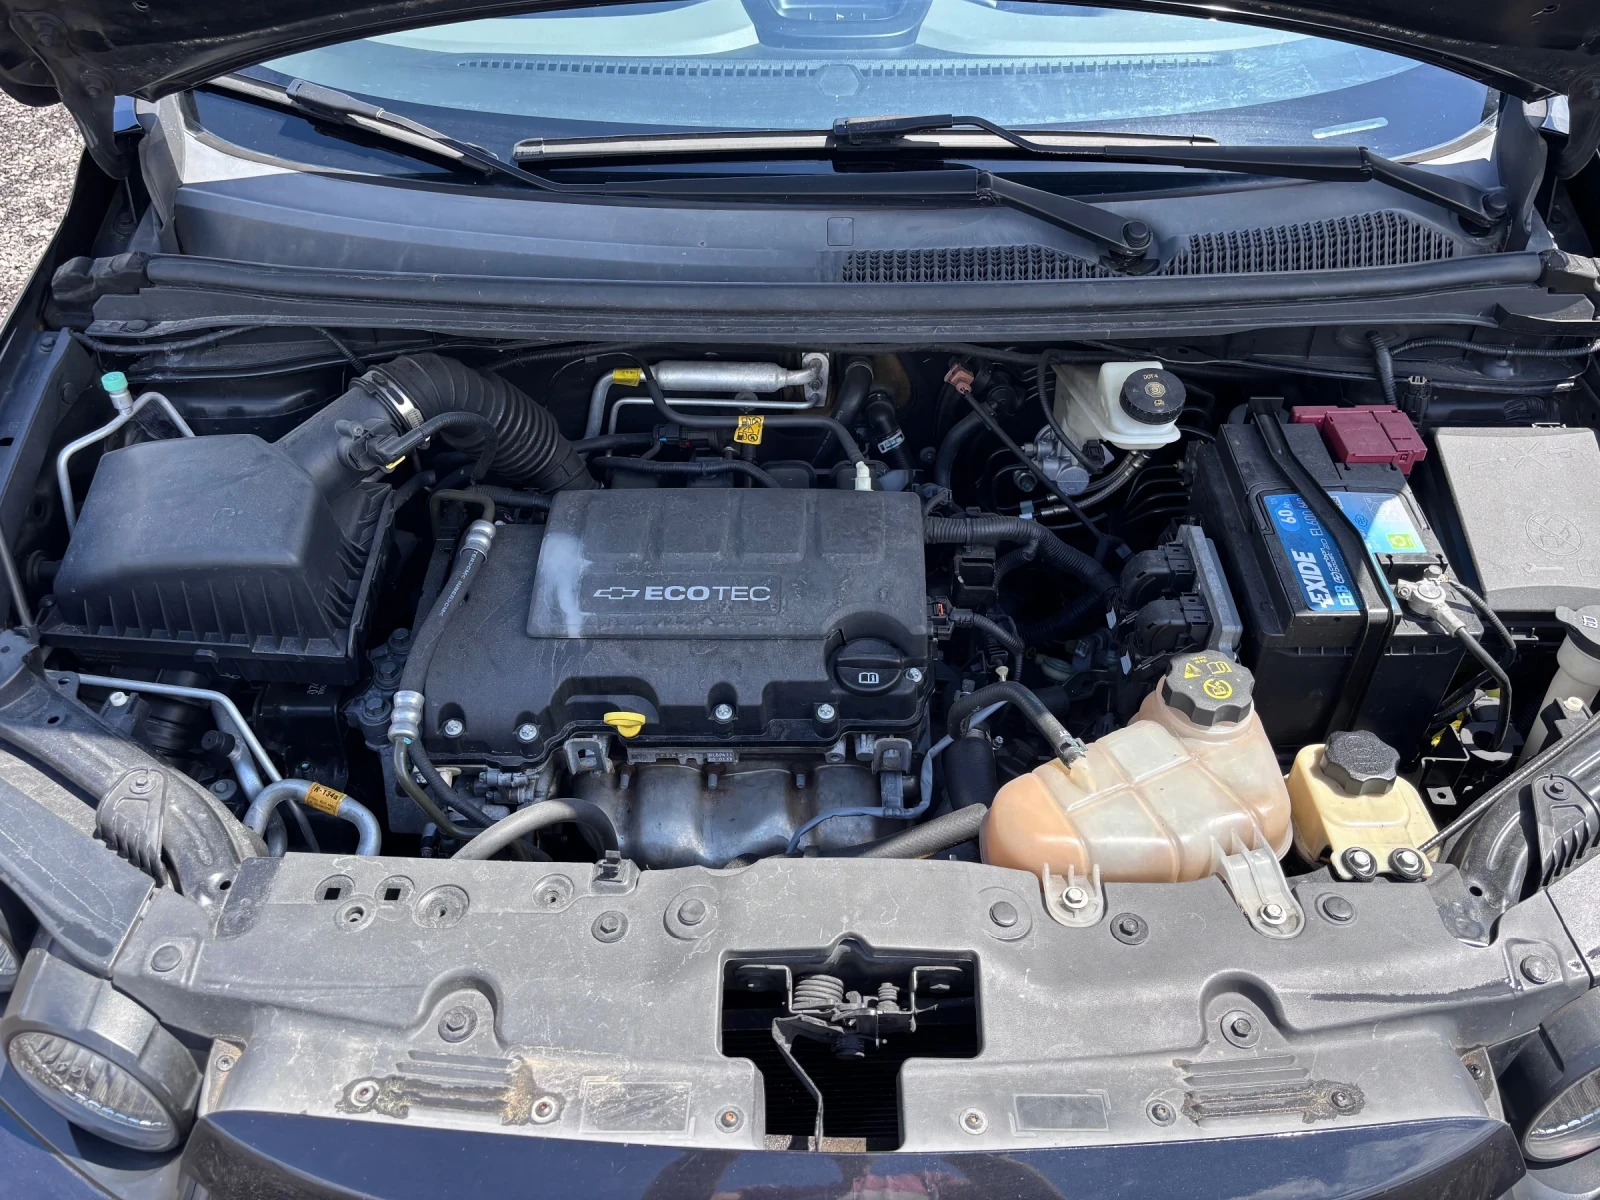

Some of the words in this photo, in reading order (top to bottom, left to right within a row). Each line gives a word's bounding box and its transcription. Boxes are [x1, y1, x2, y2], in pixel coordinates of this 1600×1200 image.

[1278, 509, 1297, 524] 60
[1291, 550, 1335, 608] EXIDE
[644, 585, 771, 602] ECOTEC
[1334, 585, 1355, 606] EFB
[313, 786, 339, 800] R-134a
